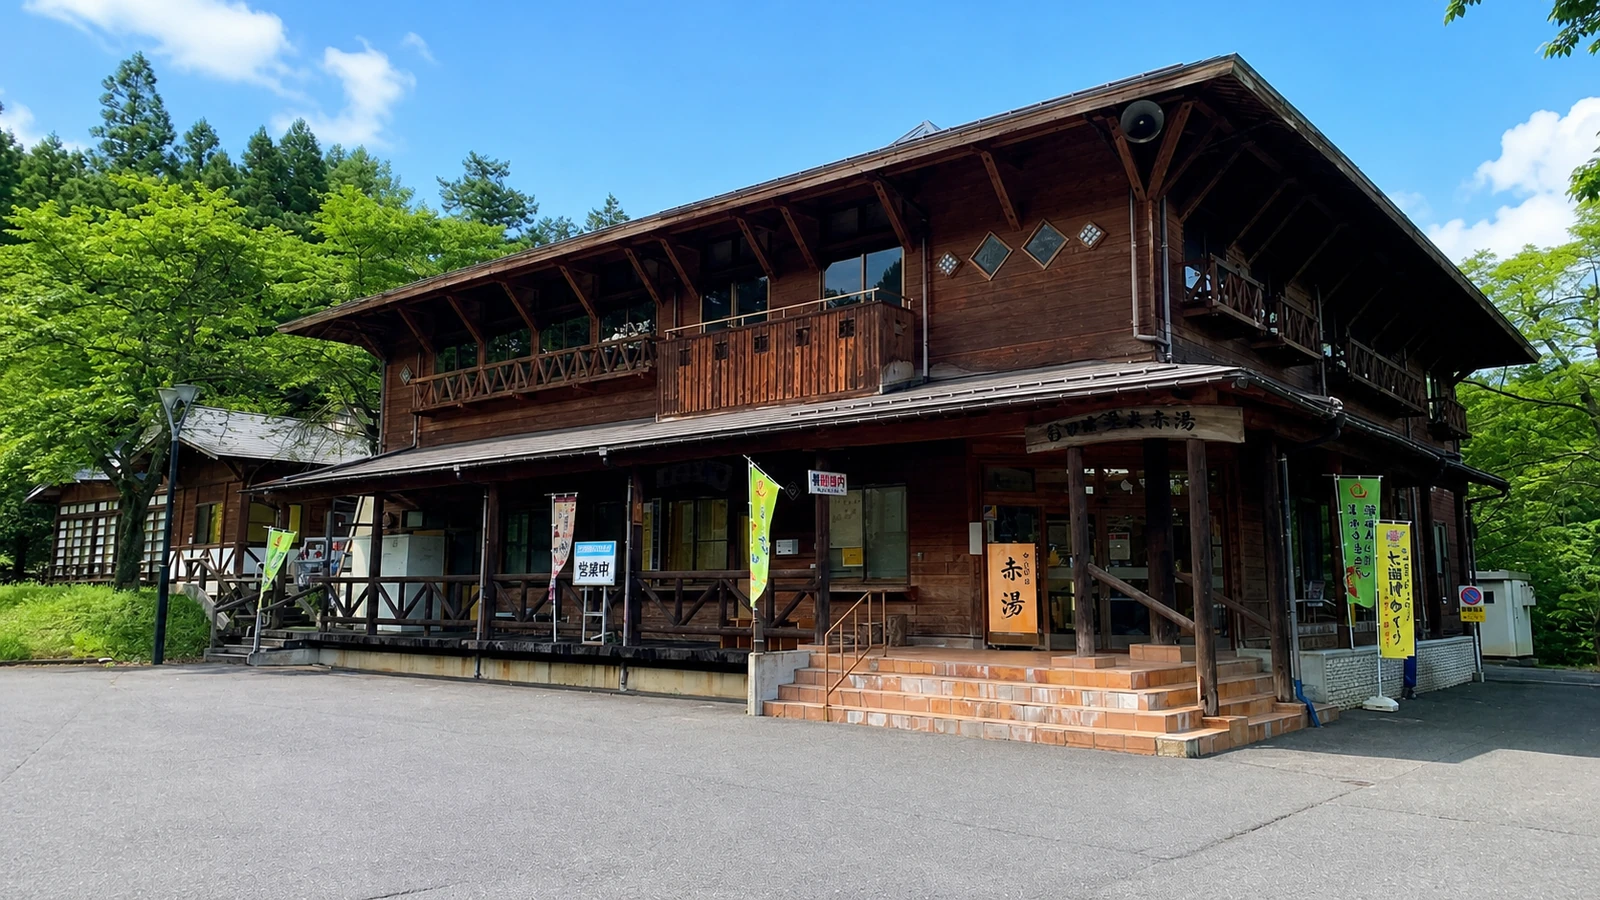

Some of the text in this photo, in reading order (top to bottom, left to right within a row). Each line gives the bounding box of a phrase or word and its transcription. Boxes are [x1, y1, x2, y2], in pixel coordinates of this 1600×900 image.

[578, 561, 610, 577] 営業中
[1001, 556, 1025, 618] 赤湯
